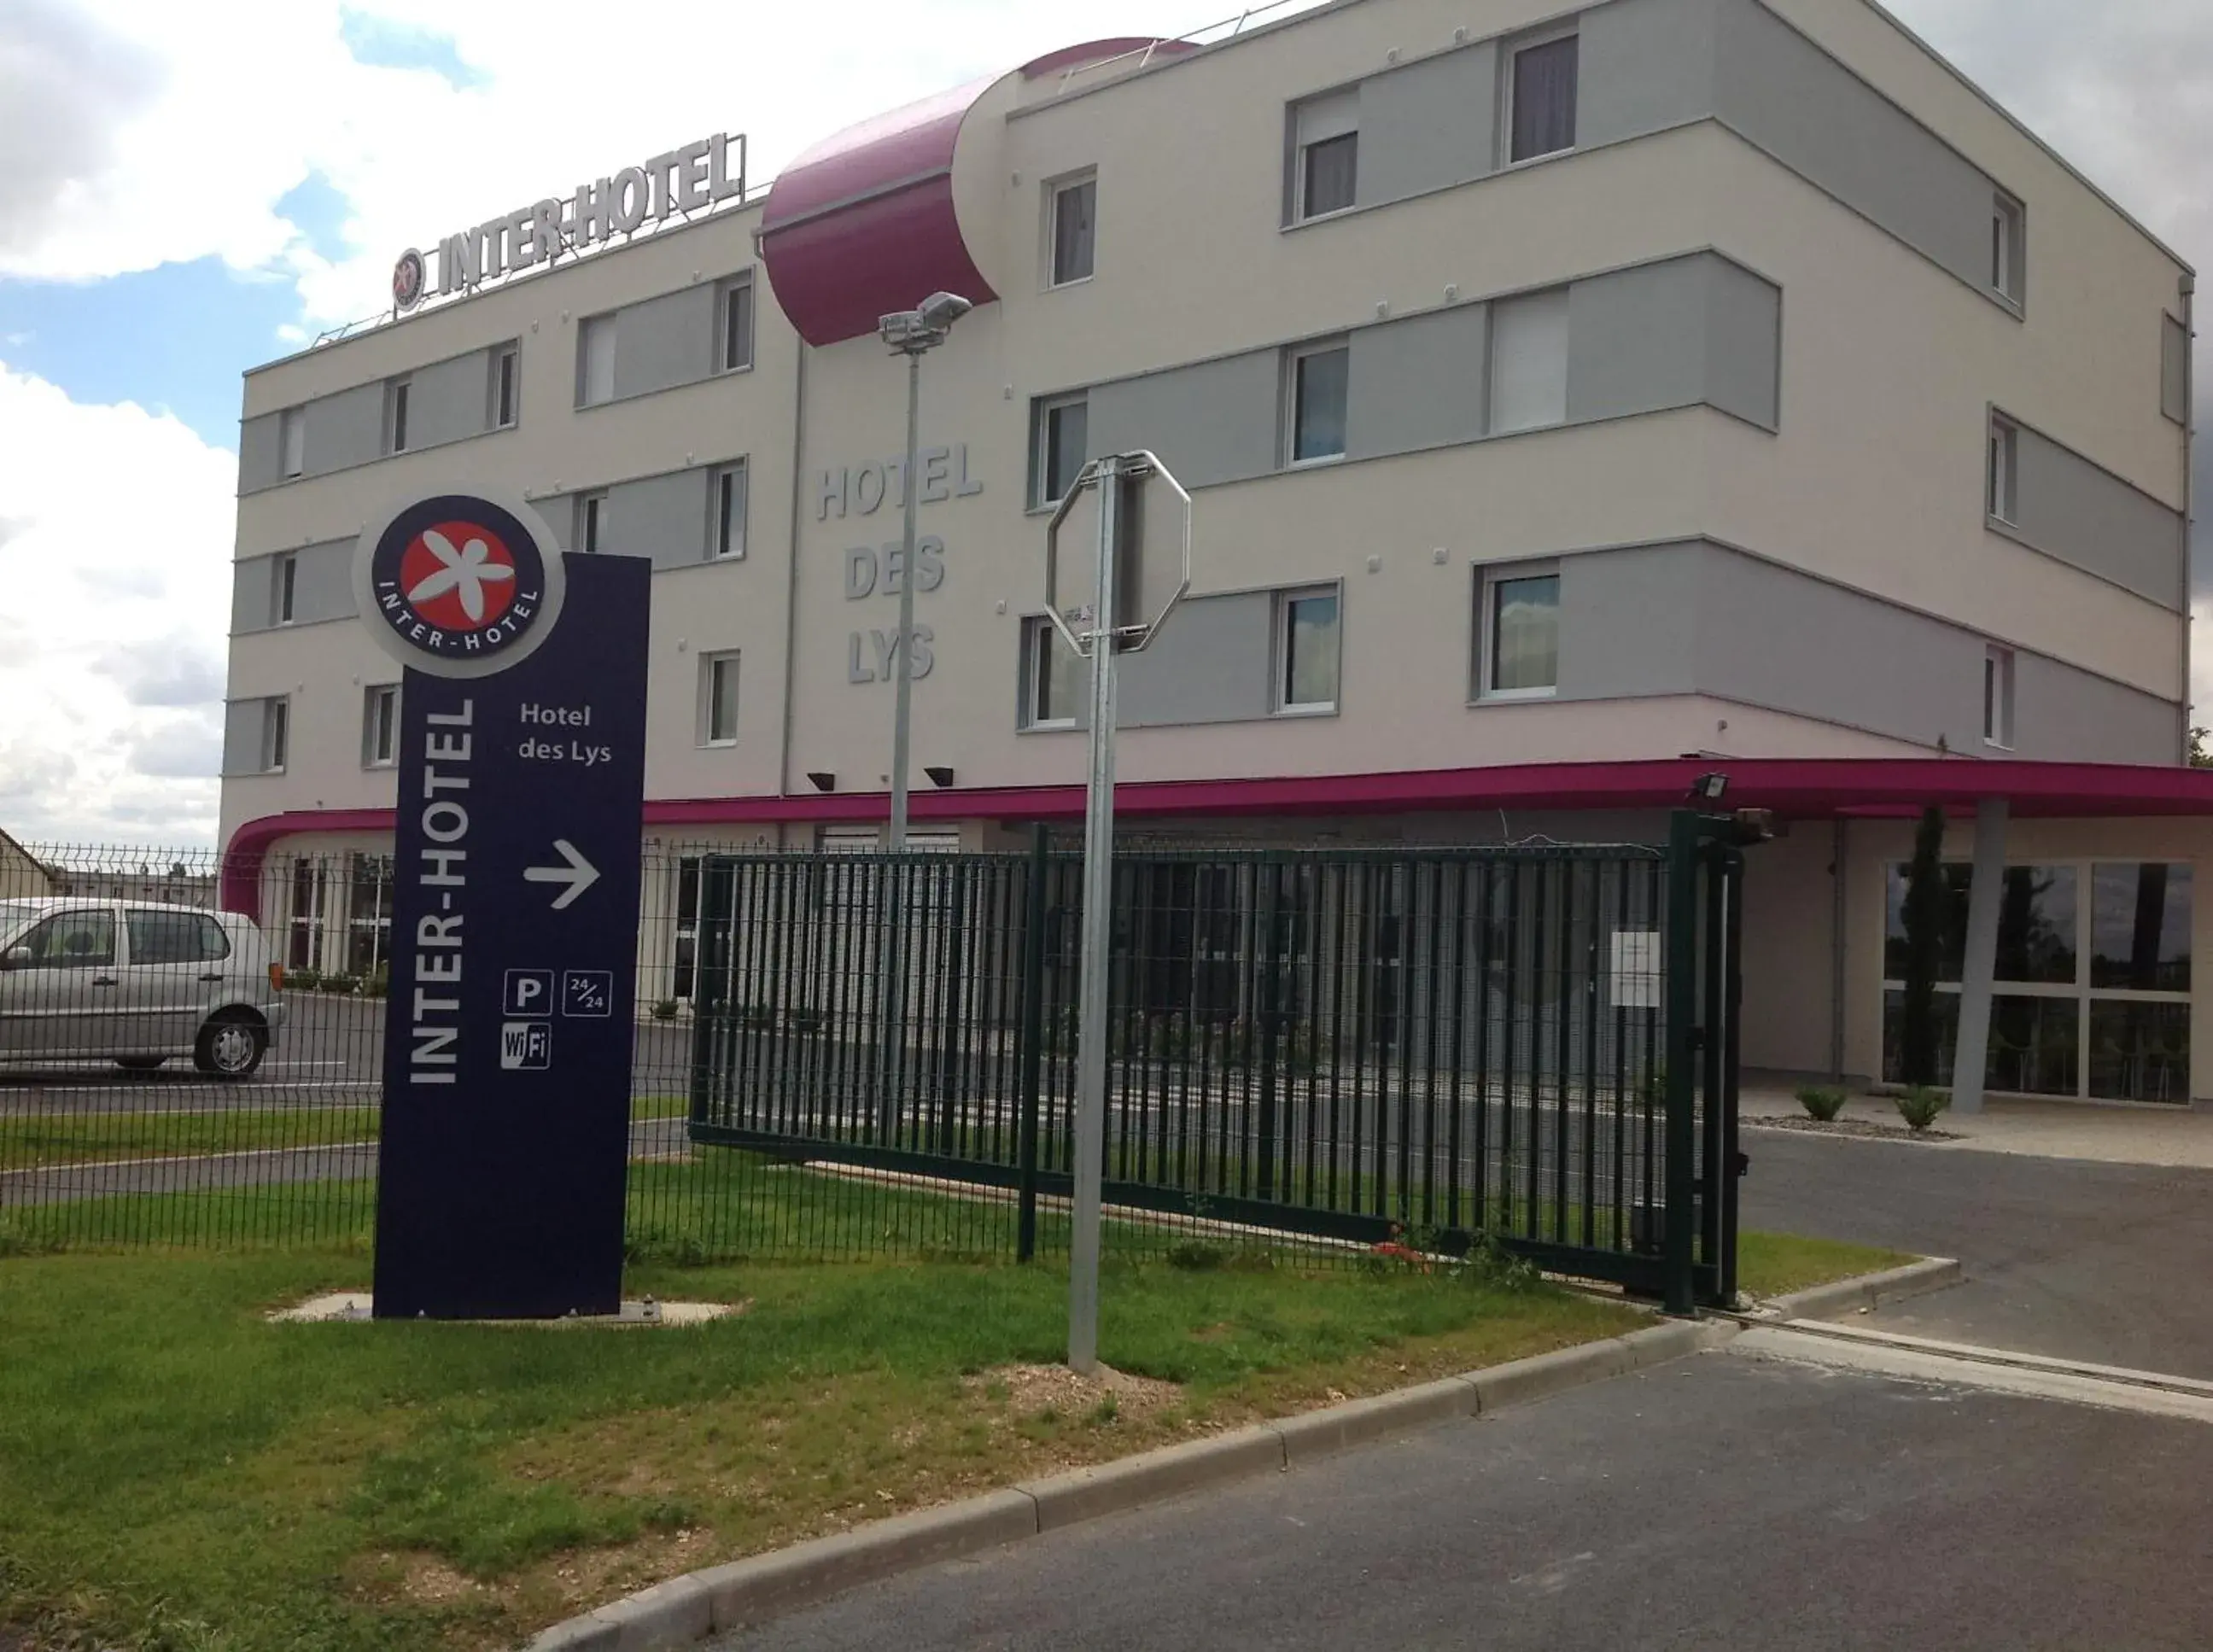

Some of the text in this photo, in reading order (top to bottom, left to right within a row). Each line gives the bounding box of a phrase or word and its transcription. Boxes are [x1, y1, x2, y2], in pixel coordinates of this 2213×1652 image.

[437, 132, 741, 295] INTER-HOTEL
[816, 442, 984, 522] HOTEL
[844, 534, 945, 601] DES
[379, 581, 538, 650] INTER-HOTEL
[849, 622, 935, 685] LYS
[520, 703, 592, 727] Hotel
[519, 738, 612, 767] des Lys
[410, 699, 474, 1083] INTER-HOTEL
[517, 978, 541, 1007] P
